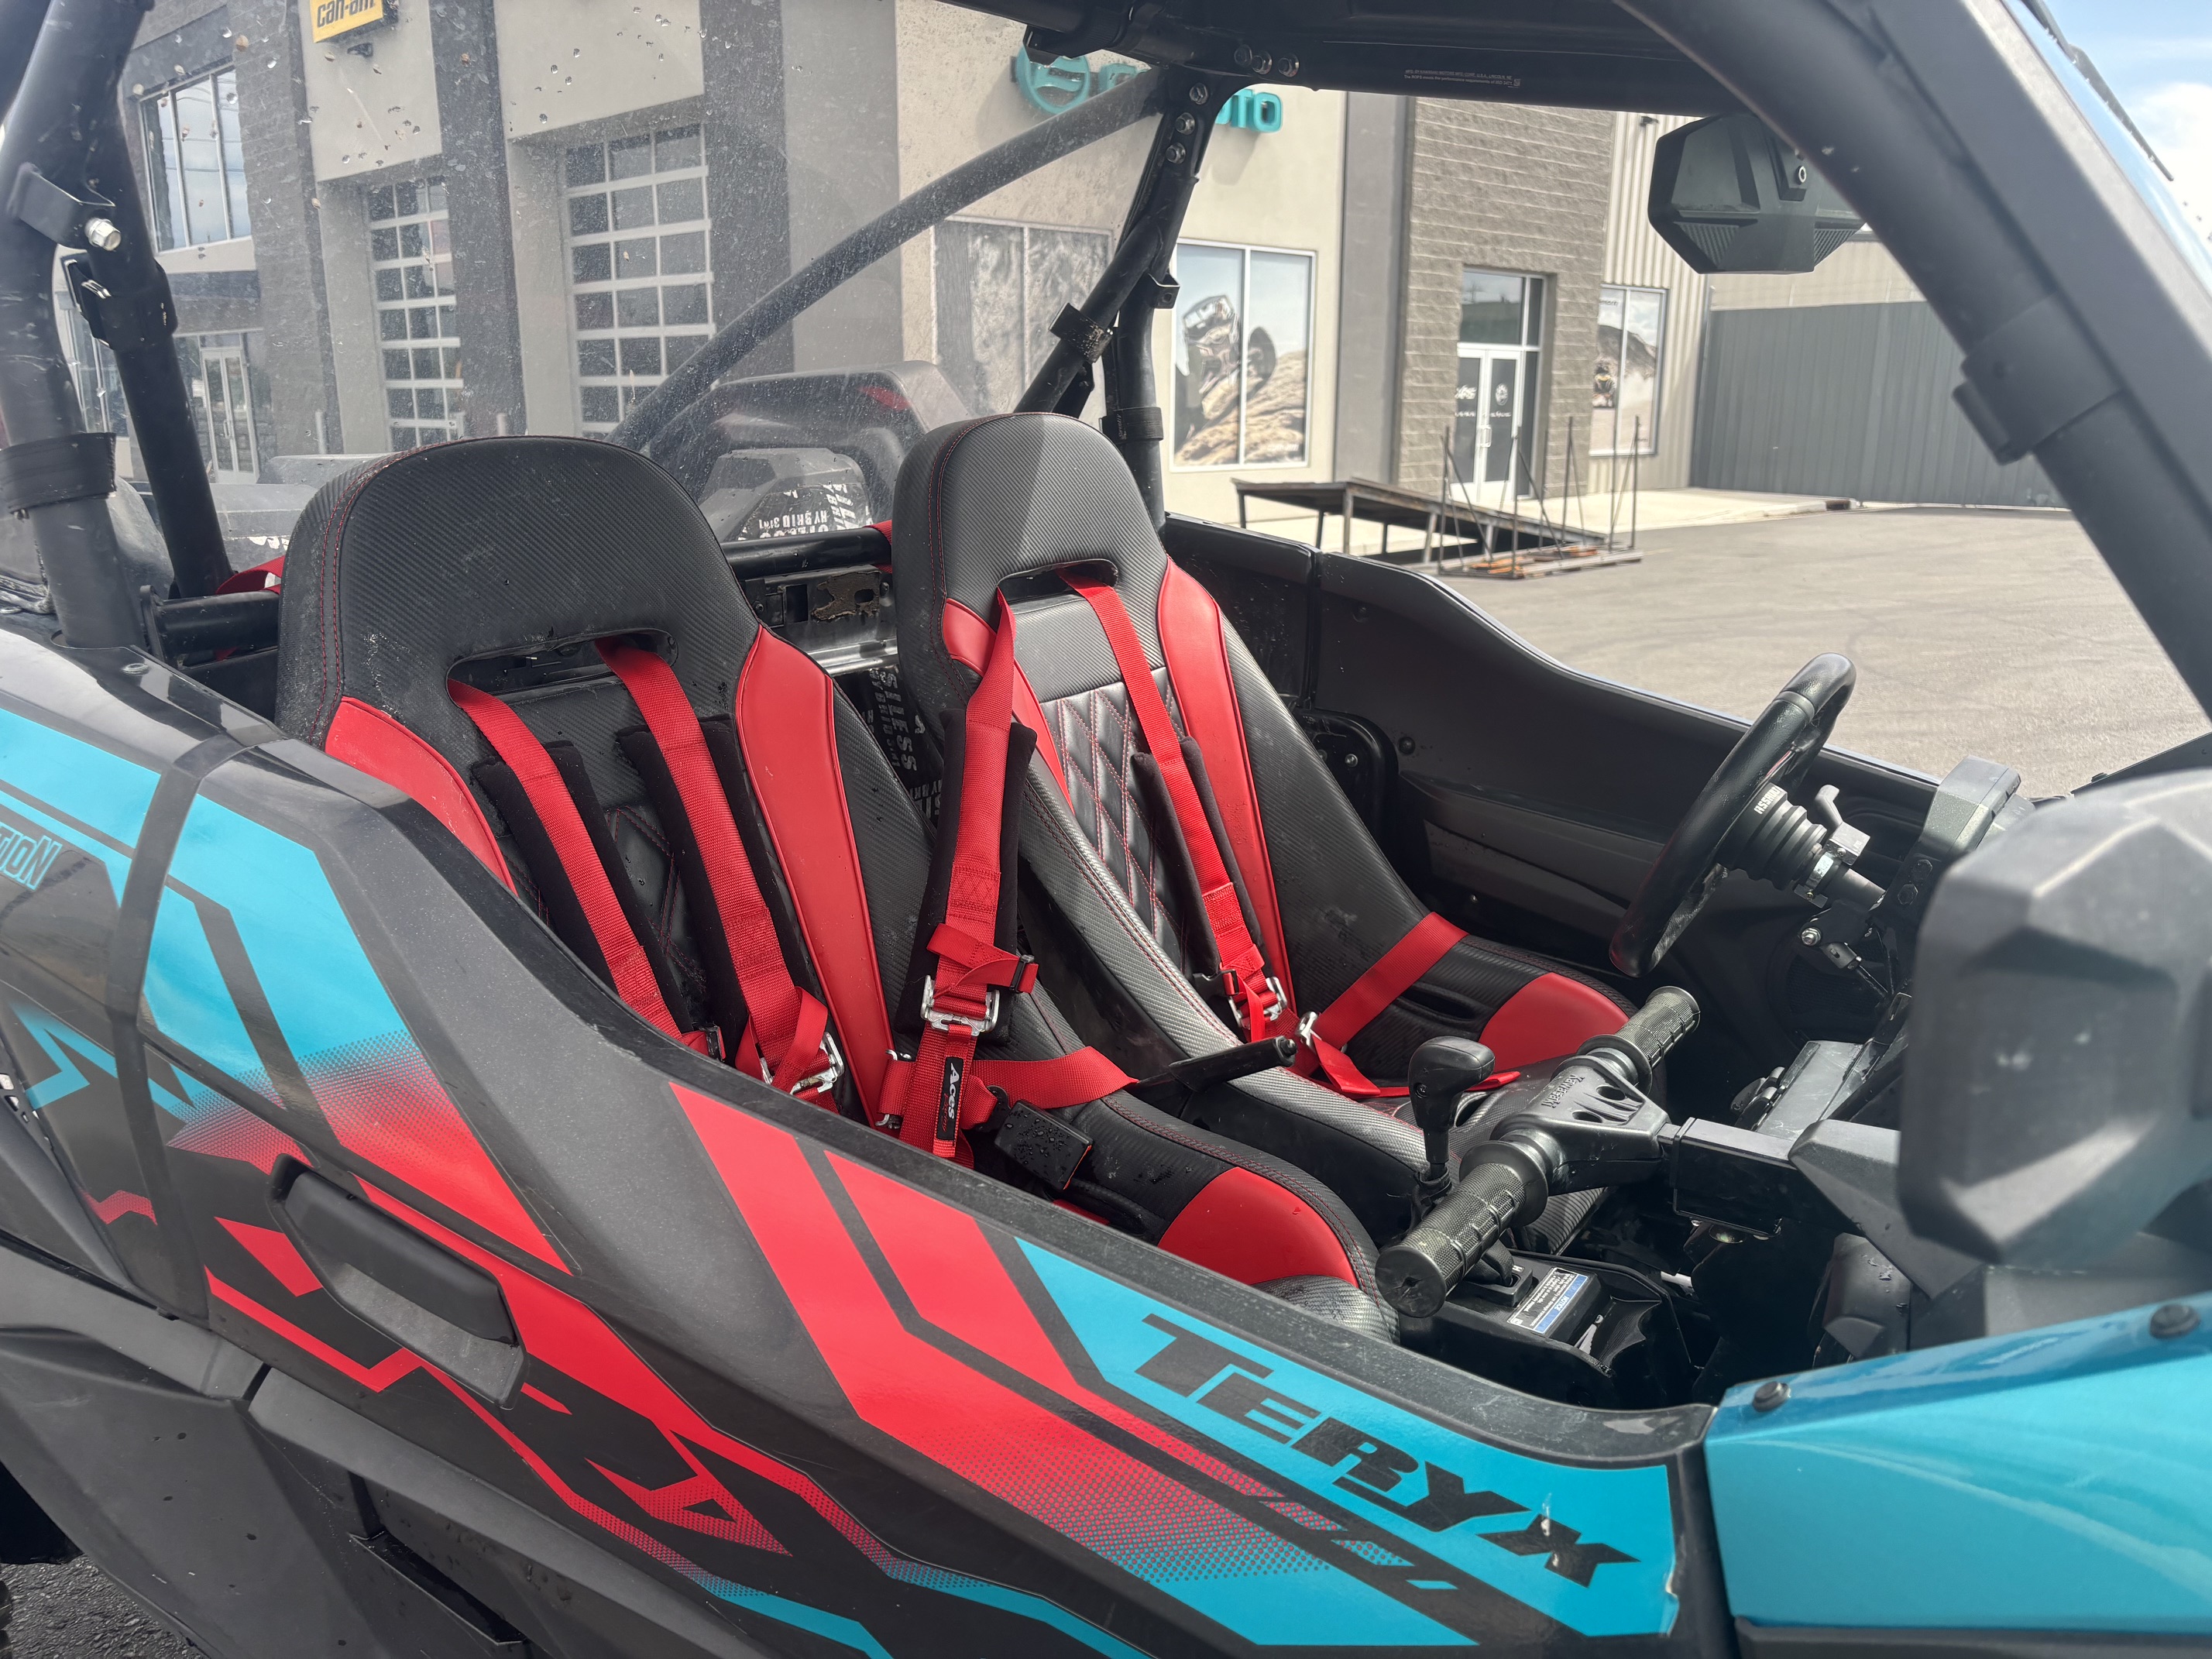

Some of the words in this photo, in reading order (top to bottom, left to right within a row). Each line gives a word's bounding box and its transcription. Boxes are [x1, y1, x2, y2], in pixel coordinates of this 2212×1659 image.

[948, 1063, 960, 1120] Aces
[1540, 1073, 1585, 1108] Kawasaki
[1554, 1296, 1570, 1311] NOTICE
[1135, 1313, 1641, 1589] TERYX
